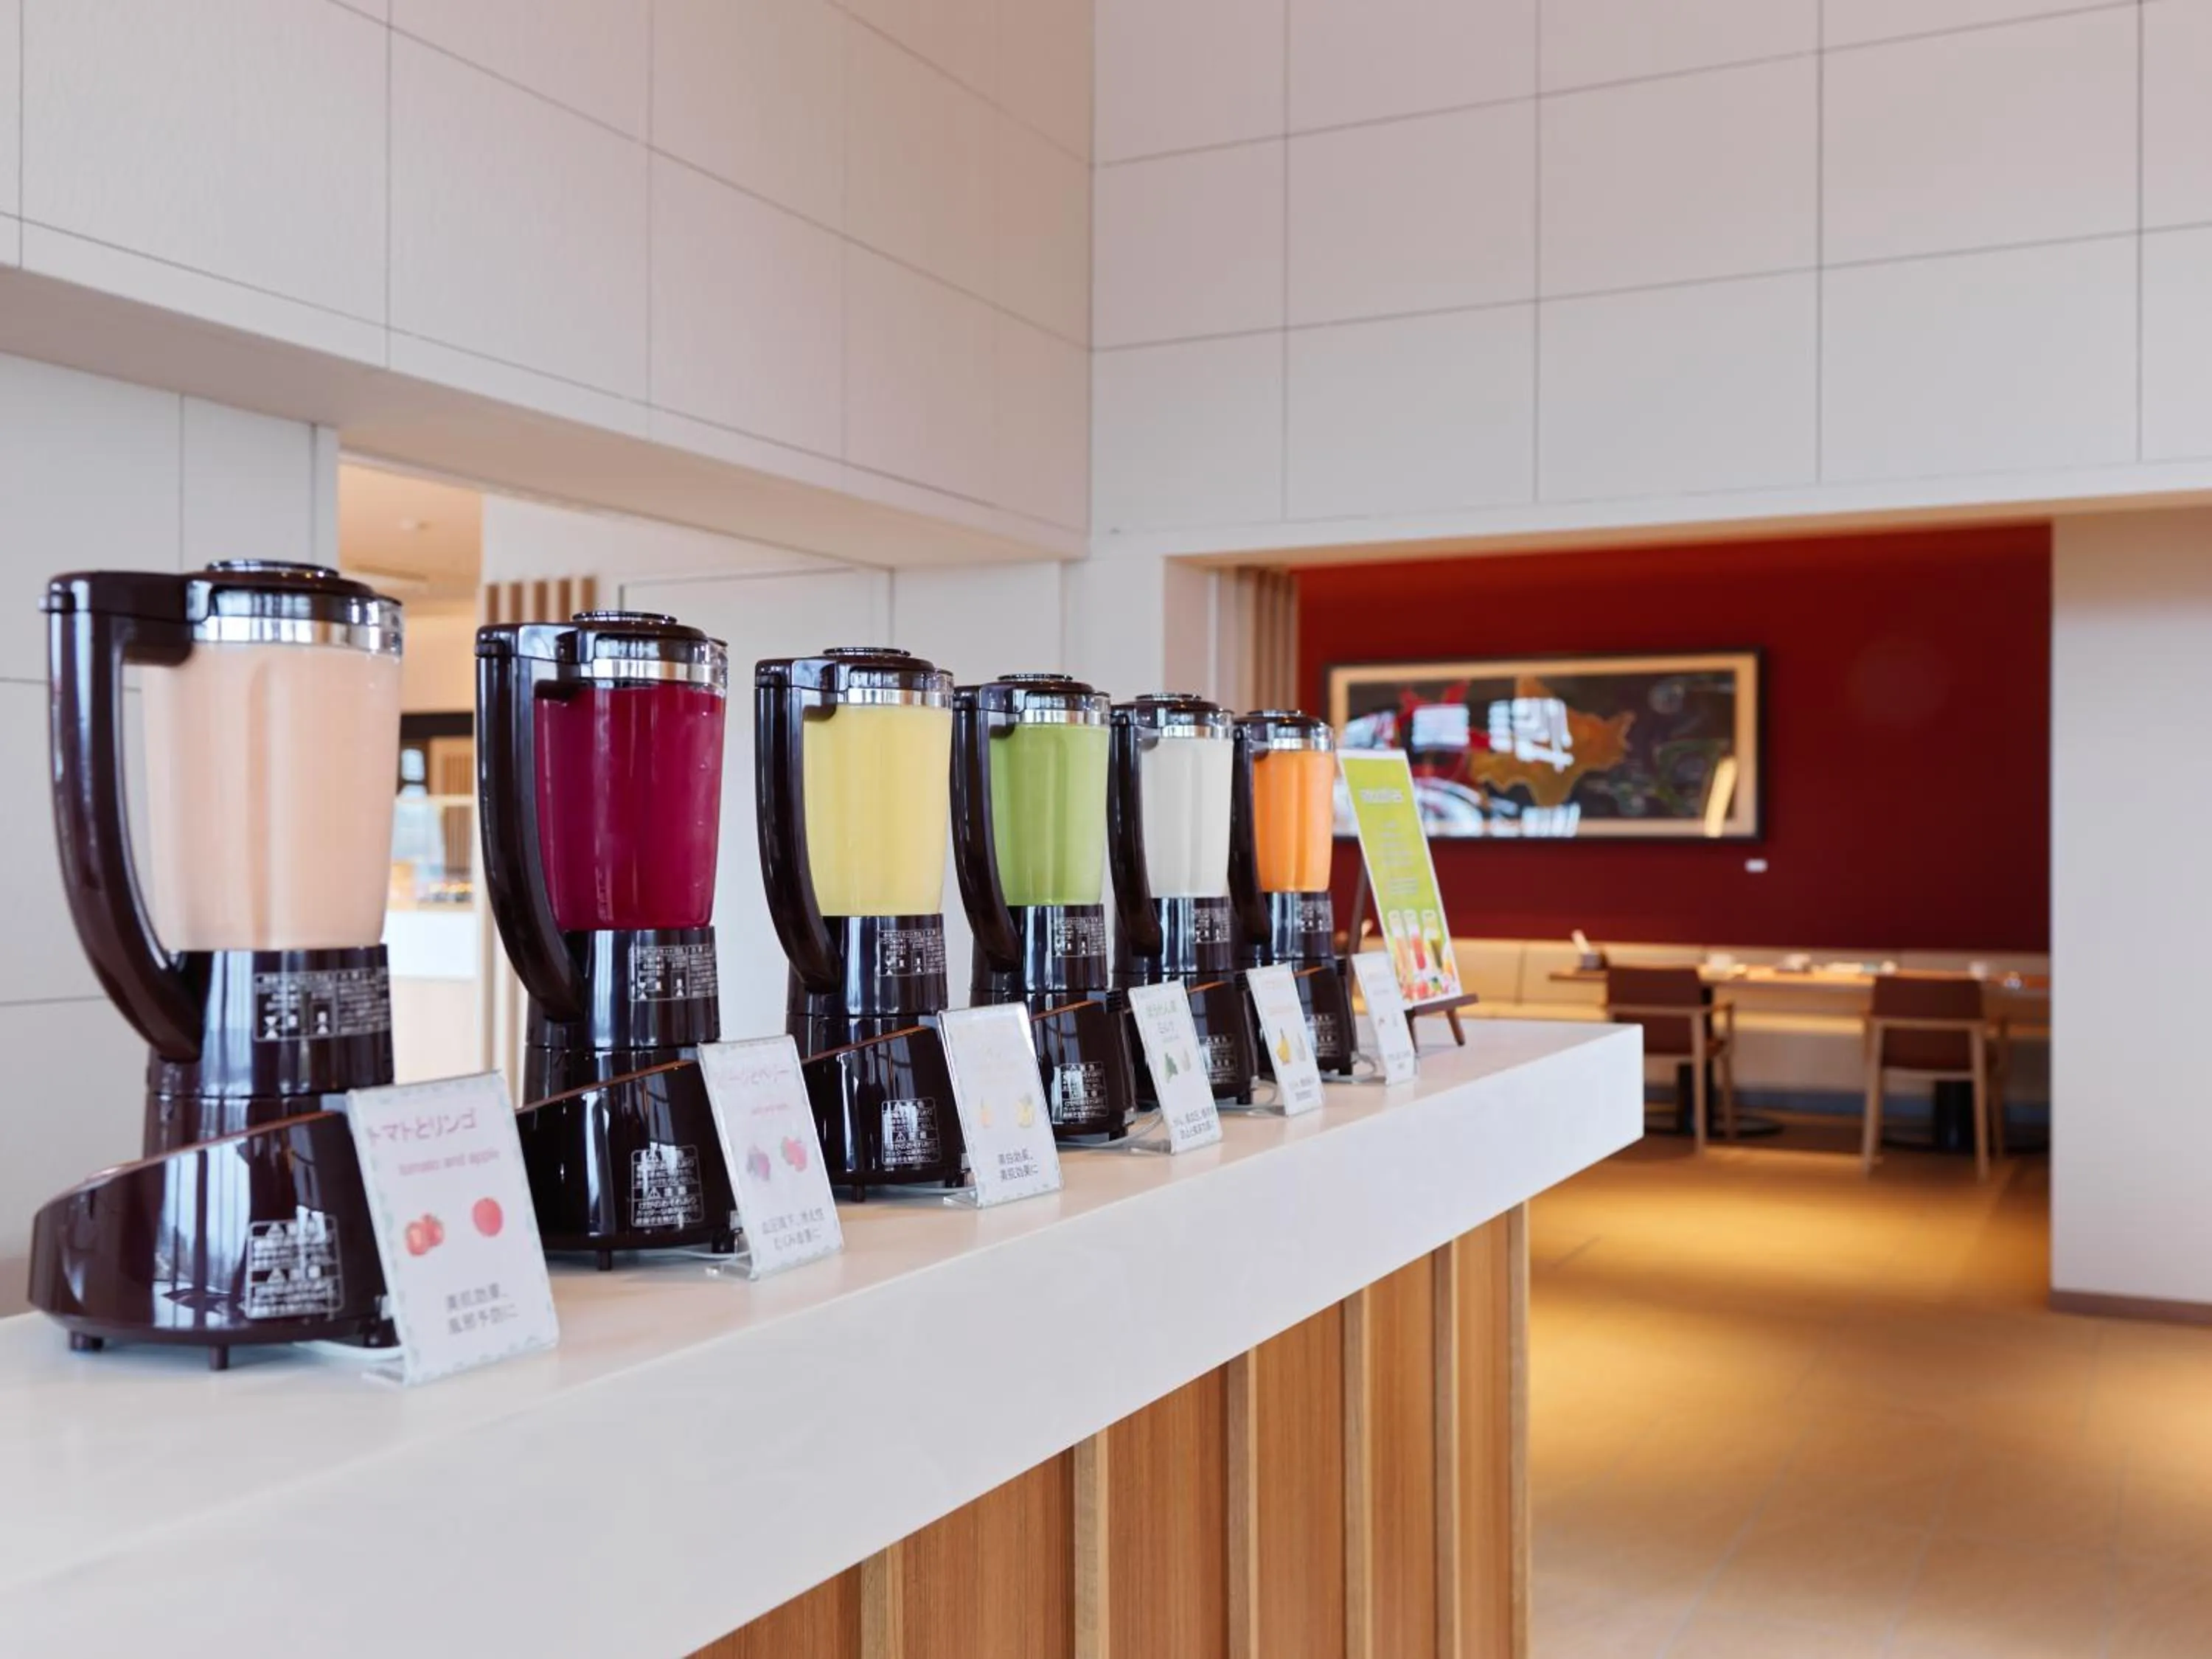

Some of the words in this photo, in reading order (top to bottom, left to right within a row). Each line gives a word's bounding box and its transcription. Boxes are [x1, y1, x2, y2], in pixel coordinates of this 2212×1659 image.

[367, 1108, 476, 1144] トマトとリンゴ
[445, 1153, 466, 1168] and
